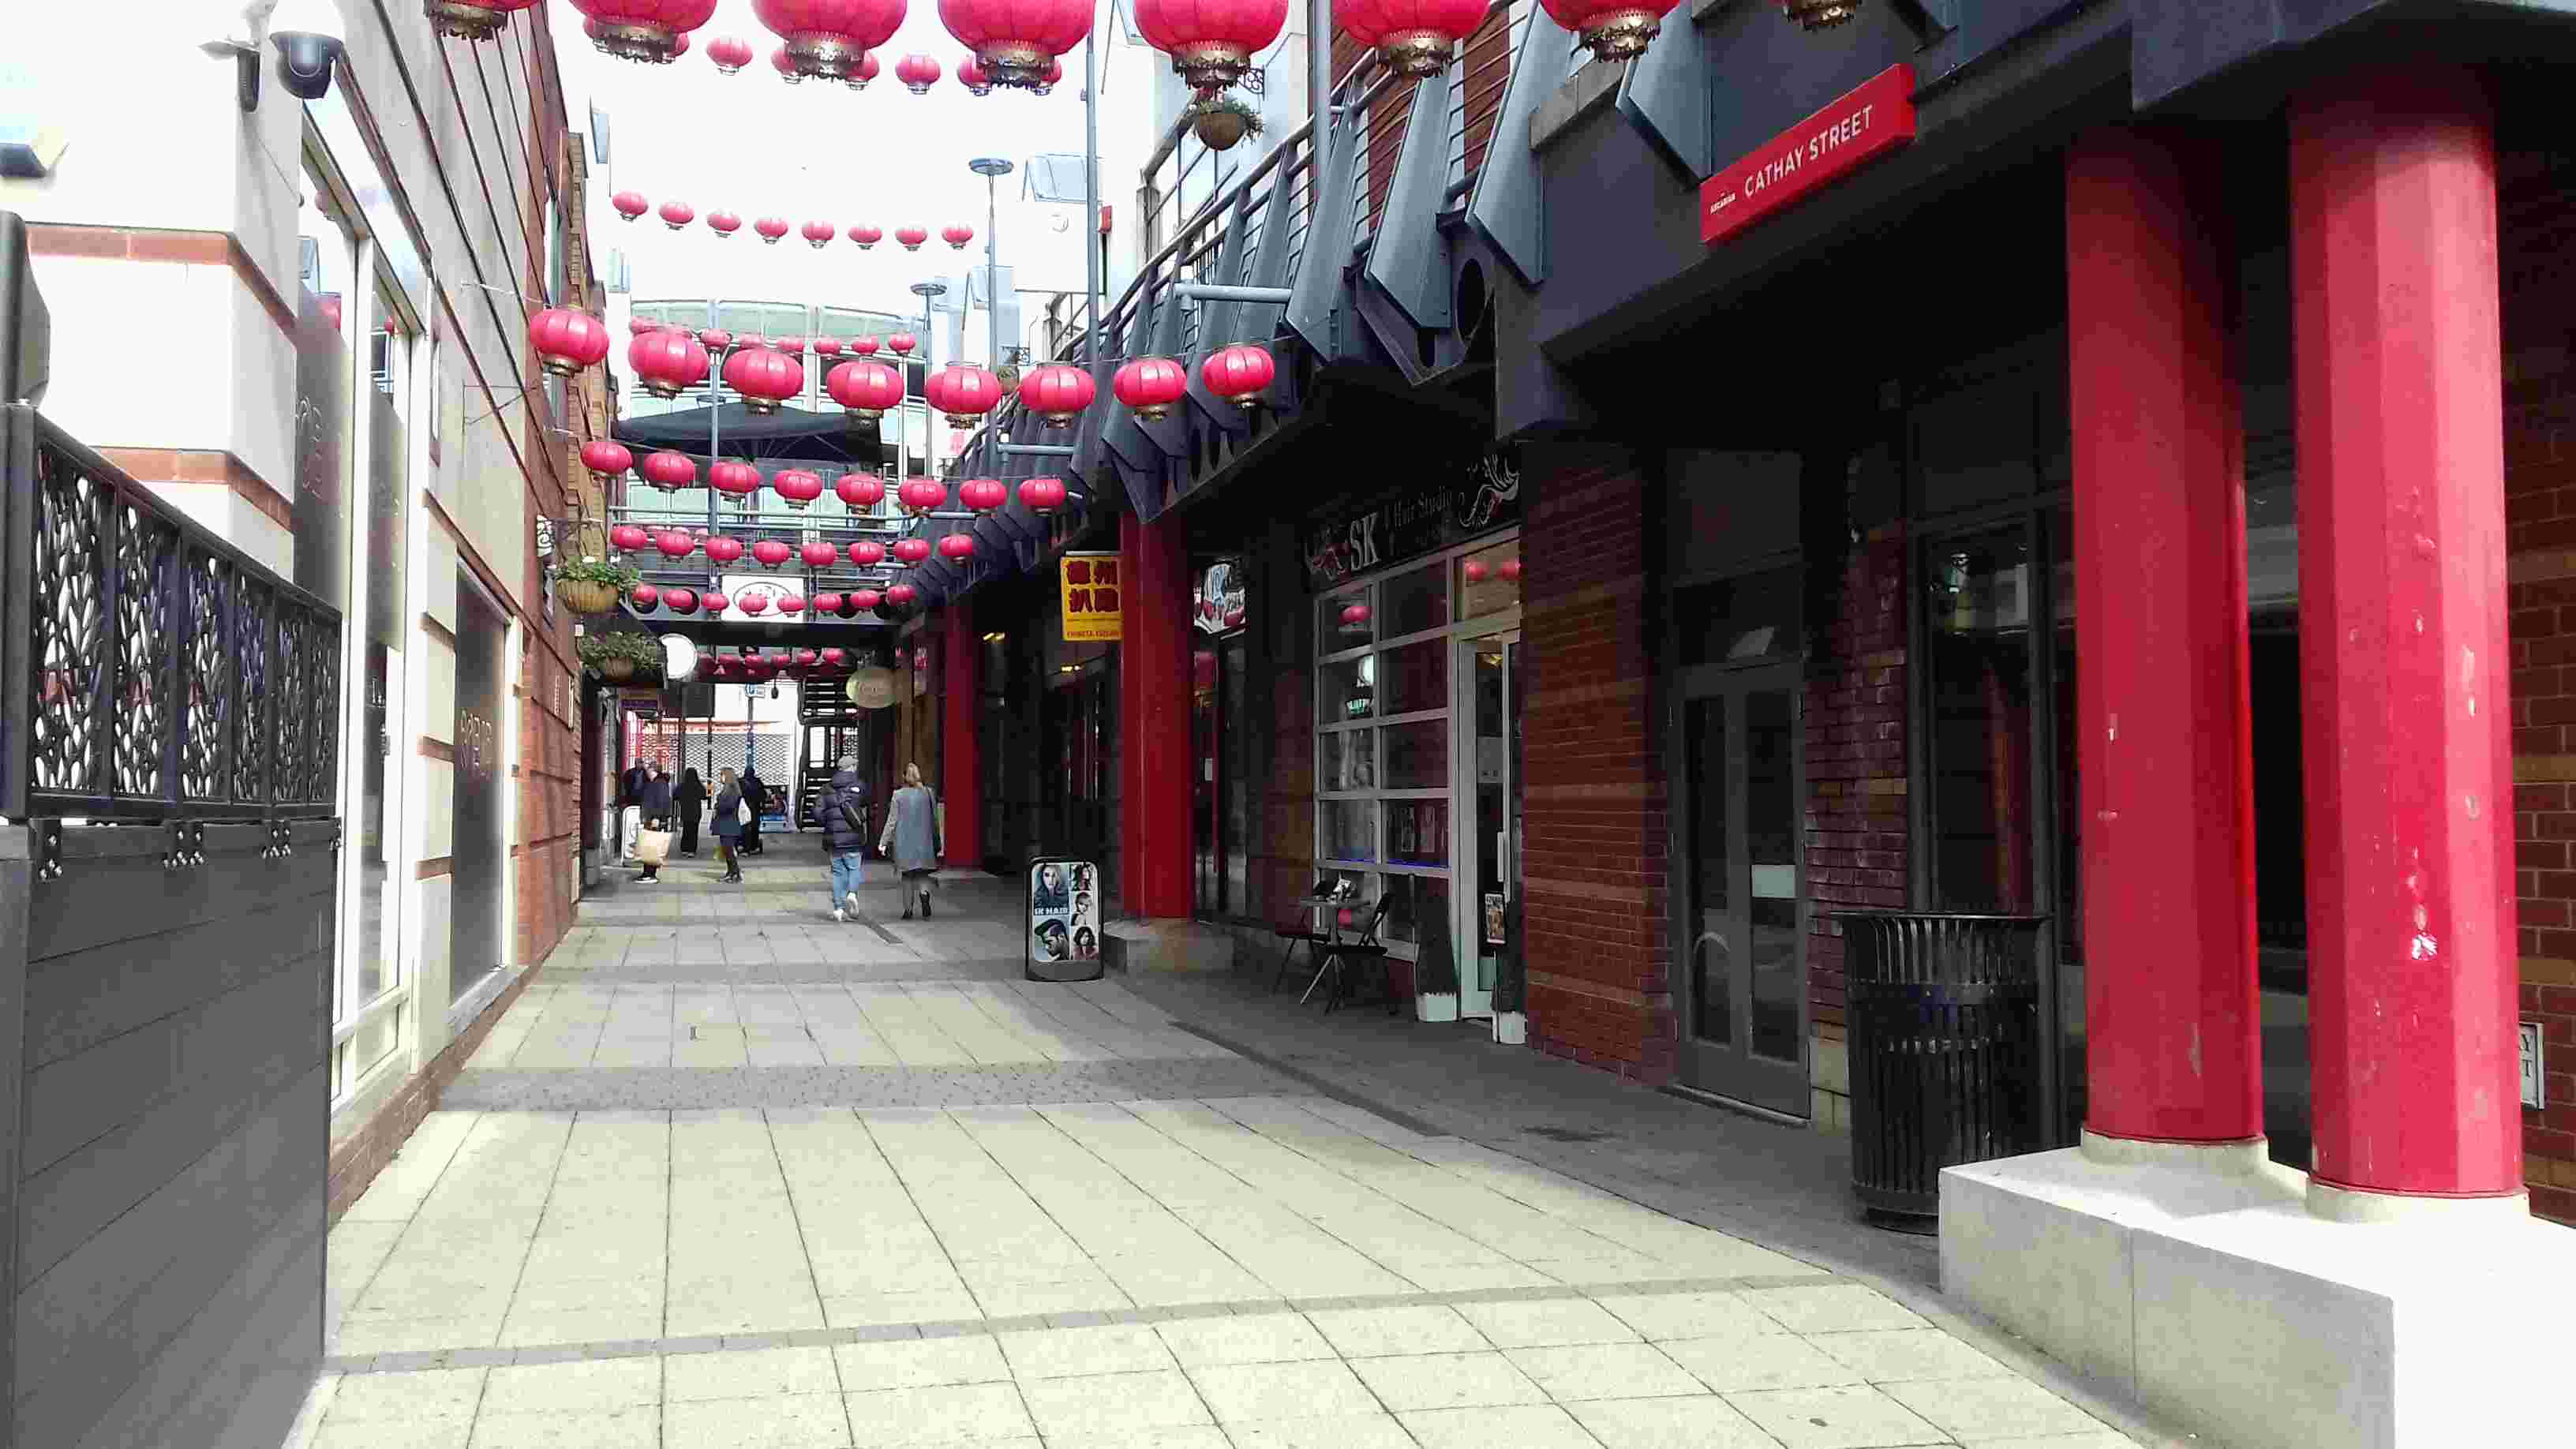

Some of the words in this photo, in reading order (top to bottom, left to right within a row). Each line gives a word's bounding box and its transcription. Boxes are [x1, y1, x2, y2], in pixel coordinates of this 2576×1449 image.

[1745, 145, 1805, 197] CATHAY
[1810, 104, 1873, 159] STREET
[1350, 511, 1381, 571] SK
